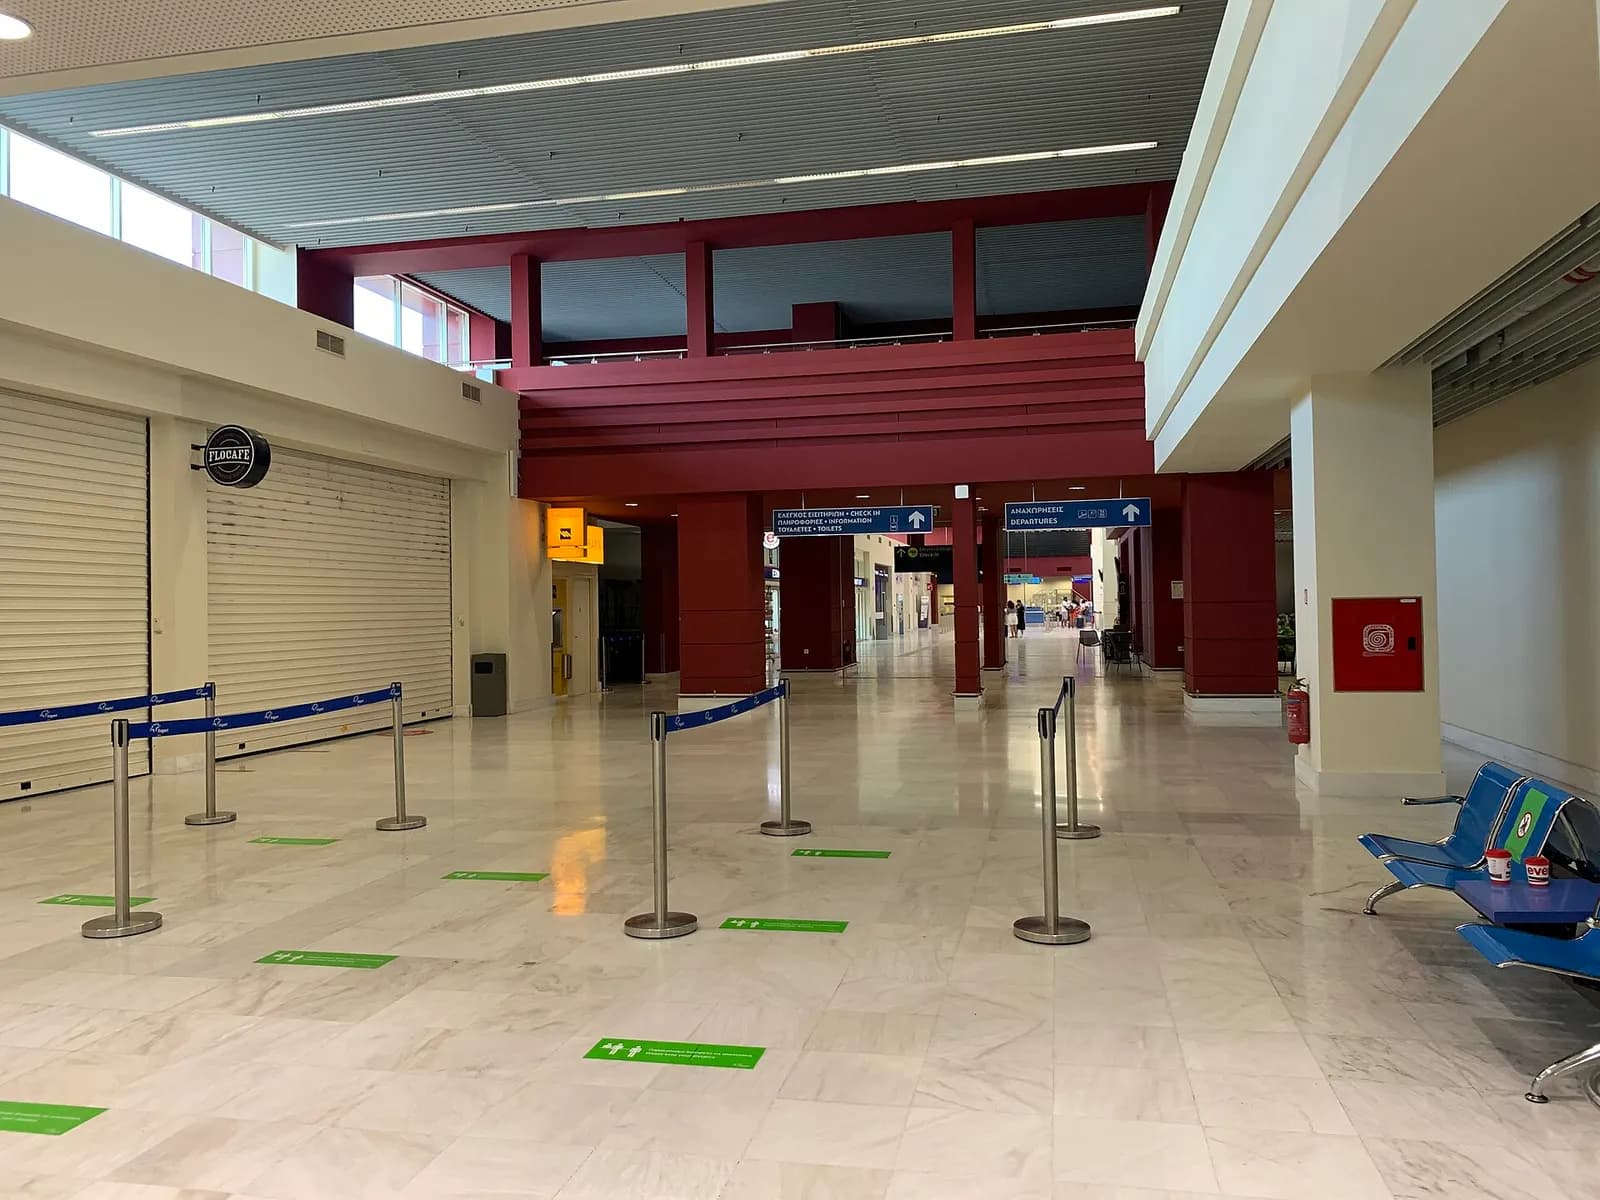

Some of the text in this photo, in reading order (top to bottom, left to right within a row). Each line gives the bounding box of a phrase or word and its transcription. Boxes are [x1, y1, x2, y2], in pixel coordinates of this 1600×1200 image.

[208, 449, 250, 462] FLOCAFE
[1010, 506, 1064, 514] ΑΝΑΧΩΡΗΣΕΙΣ
[1010, 517, 1058, 525] DEPARTURES
